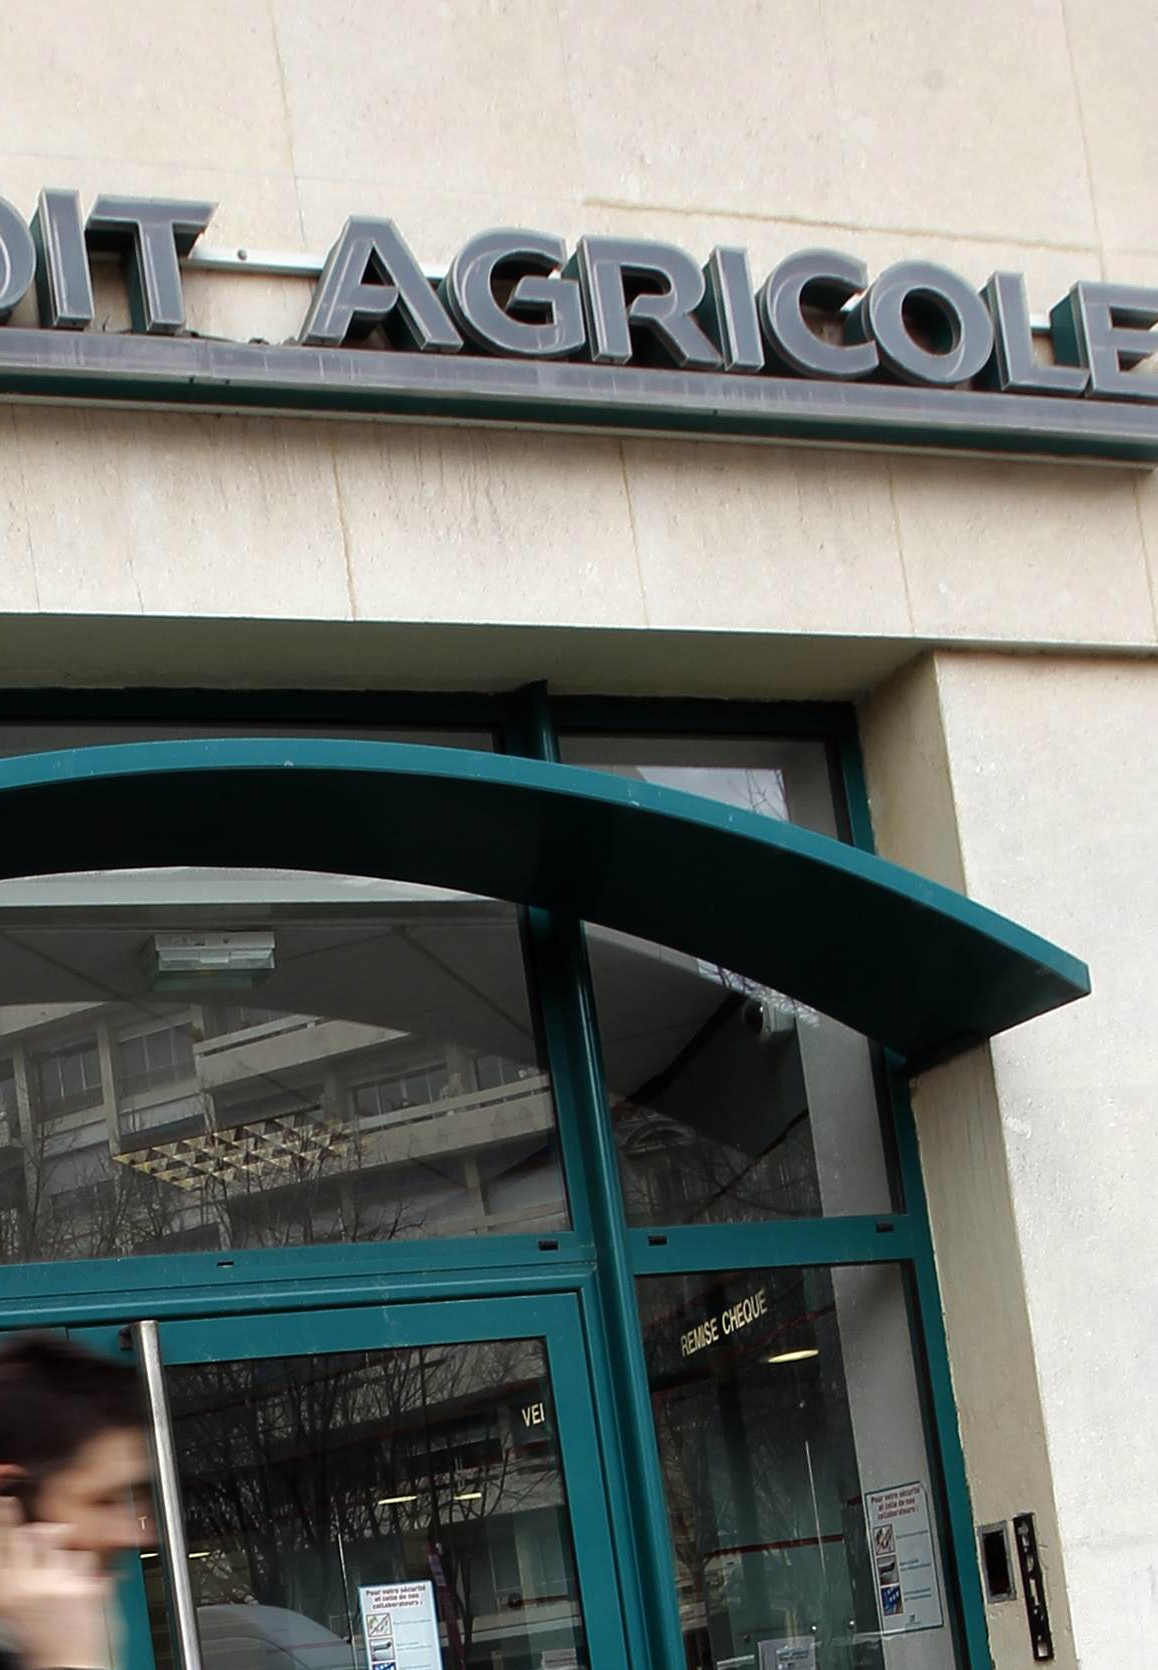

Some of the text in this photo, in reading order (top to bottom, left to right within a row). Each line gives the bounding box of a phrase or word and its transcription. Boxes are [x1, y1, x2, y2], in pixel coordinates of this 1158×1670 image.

[299, 214, 1158, 402] AGRICOLE
[681, 1288, 768, 1358] REMISE CHEQUE
